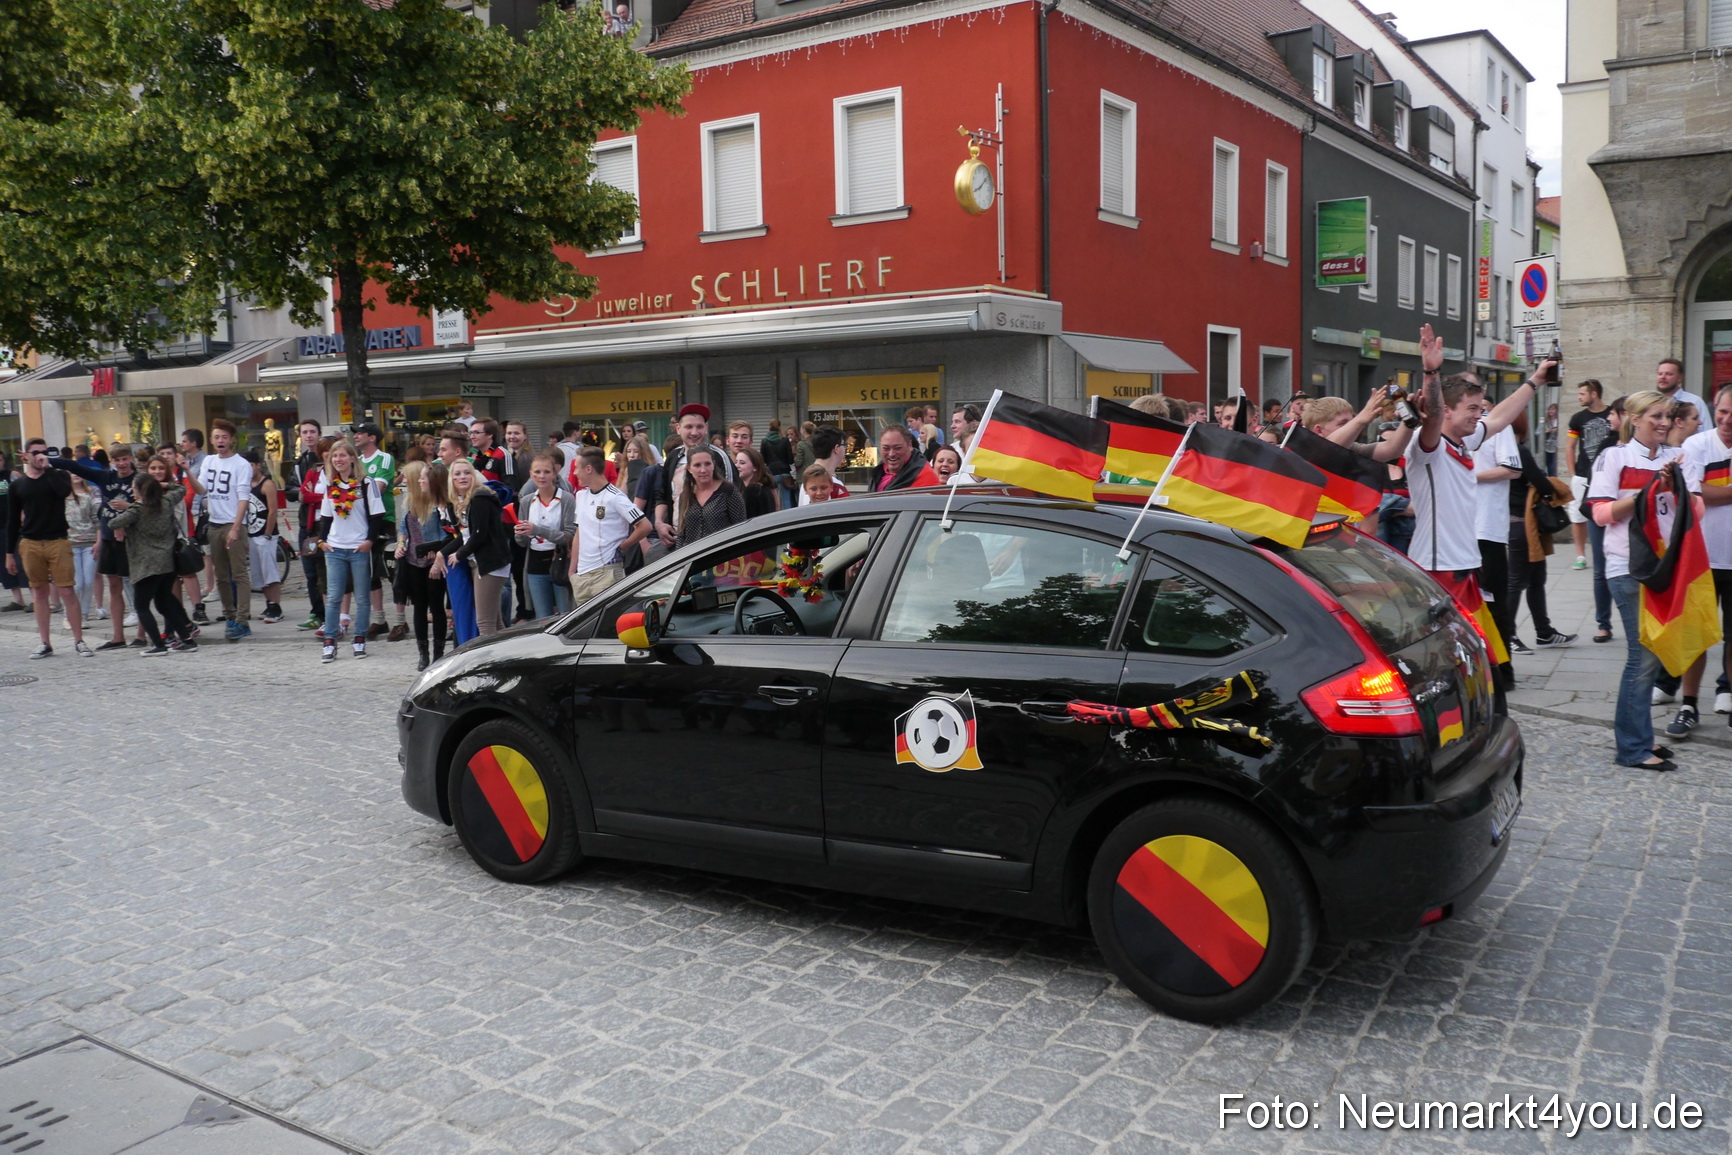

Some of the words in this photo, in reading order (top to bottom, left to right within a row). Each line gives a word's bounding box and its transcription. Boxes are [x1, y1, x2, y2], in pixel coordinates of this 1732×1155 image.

[1322, 262, 1350, 270] dess
[1478, 256, 1491, 299] MERZ
[596, 293, 673, 318] juwelier
[691, 257, 893, 305] SCHLIERF
[1522, 309, 1545, 323] ZONE
[438, 319, 458, 329] PRESSE
[1010, 318, 1046, 331] SCHLIERF
[462, 385, 478, 394] NZ
[859, 386, 940, 401] SCHLIERF
[610, 399, 672, 413] SCHLIERF
[813, 412, 823, 421] 25
[822, 412, 839, 421] Jahre
